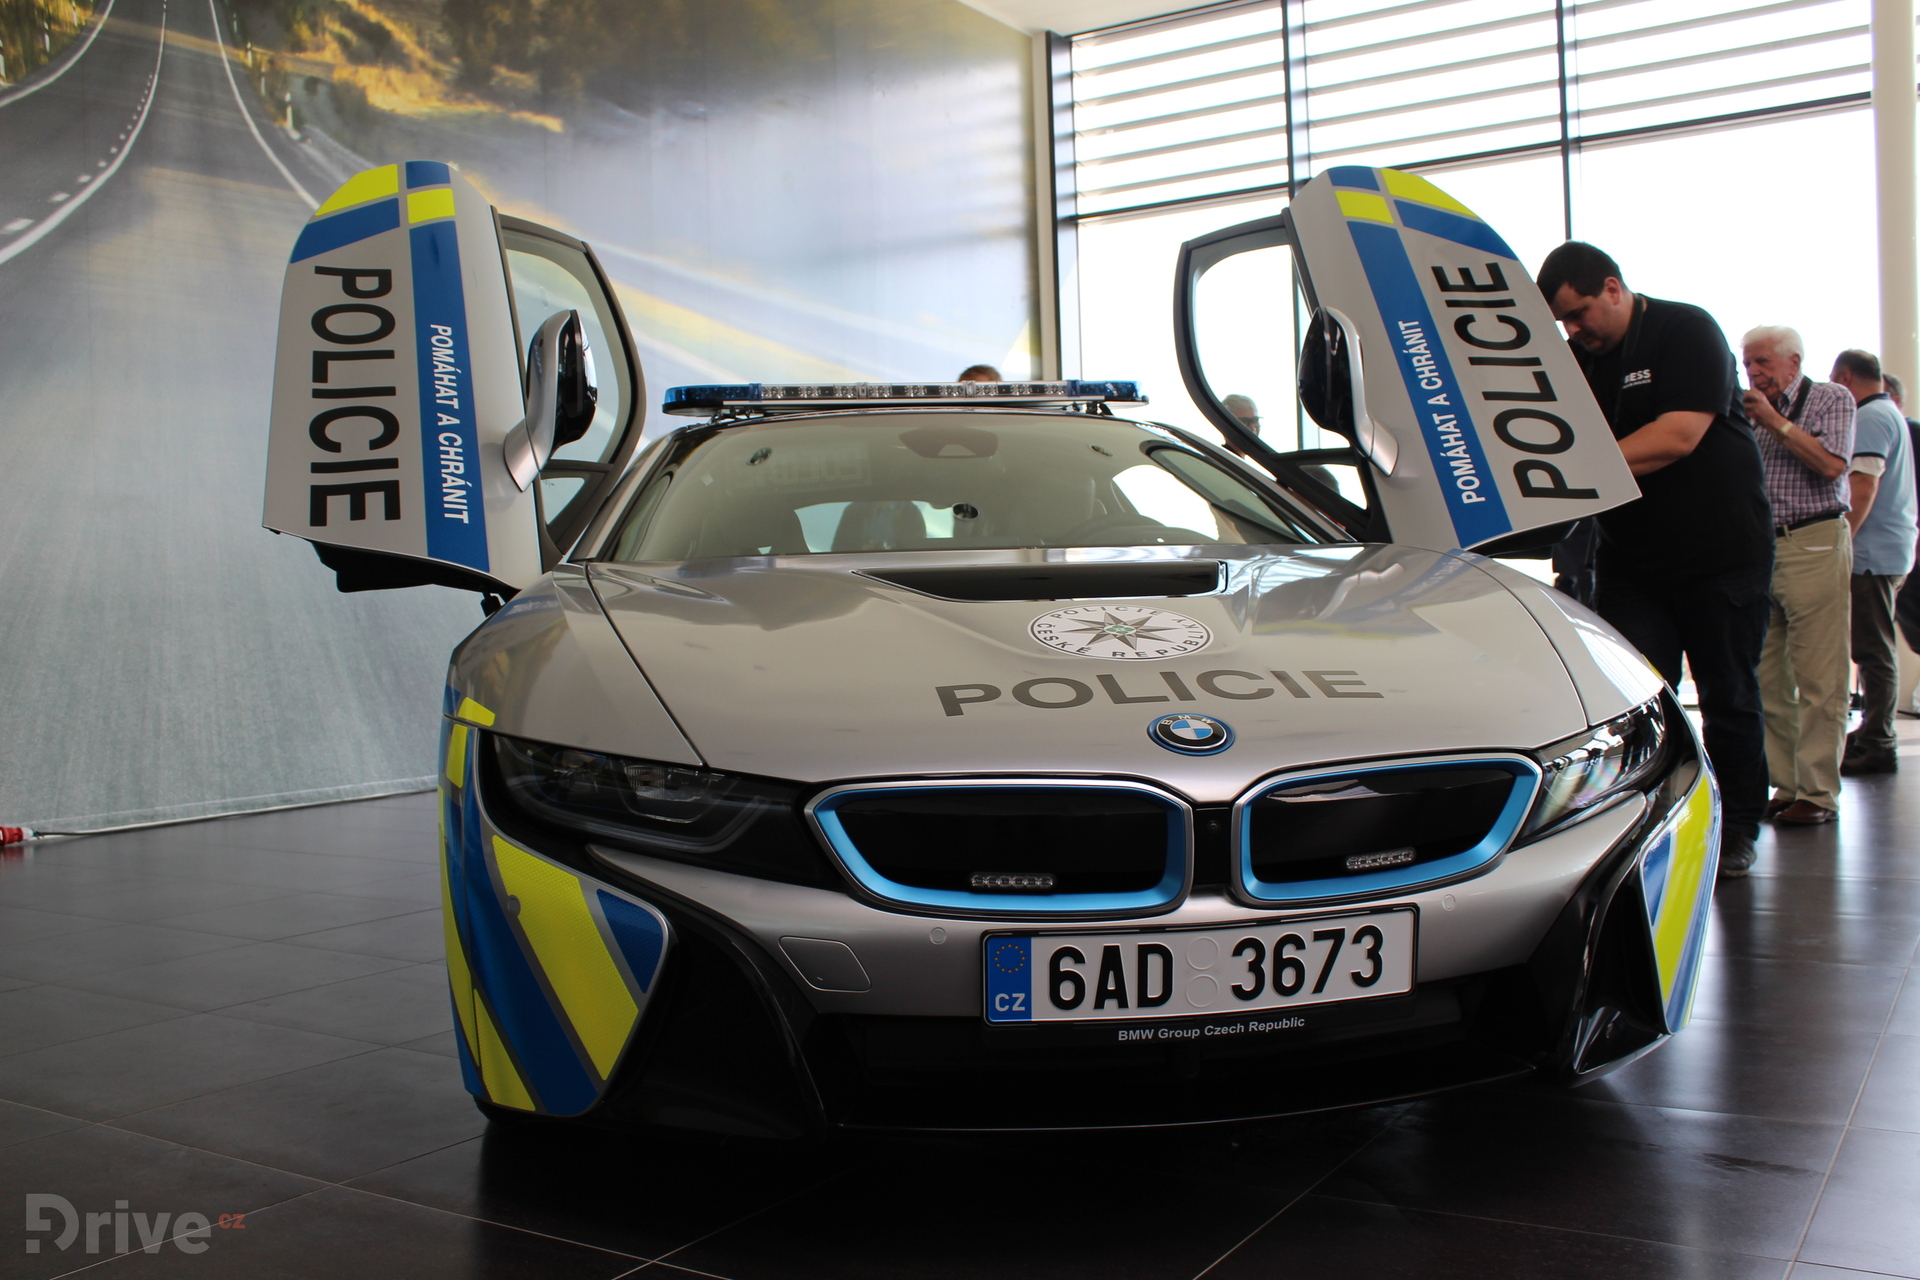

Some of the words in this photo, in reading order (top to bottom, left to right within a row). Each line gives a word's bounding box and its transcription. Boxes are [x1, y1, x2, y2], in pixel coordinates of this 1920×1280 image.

[430, 324, 460, 410] POMÁHAT
[1398, 320, 1442, 391] CHRÁNIT
[1431, 262, 1600, 500] POLICIE
[309, 266, 401, 527] POLICIE
[437, 412, 460, 427] A
[1427, 393, 1451, 406] A
[438, 432, 472, 524] CHRÁNIT
[1432, 413, 1486, 504] POMÁHAT
[1037, 622, 1092, 655] ČESKÉ
[1112, 617, 1204, 658] REPUBLIKY
[1050, 606, 1164, 619] POLICIE
[934, 669, 1385, 717] POLICIE
[1048, 941, 1174, 1011] 6AD
[1230, 923, 1384, 1002] 3673
[994, 993, 1026, 1012] CZ
[1117, 1028, 1155, 1041] BMW
[1157, 1025, 1201, 1041] Group
[1204, 1022, 1245, 1036] Czech
[1248, 1016, 1306, 1035] Republic
